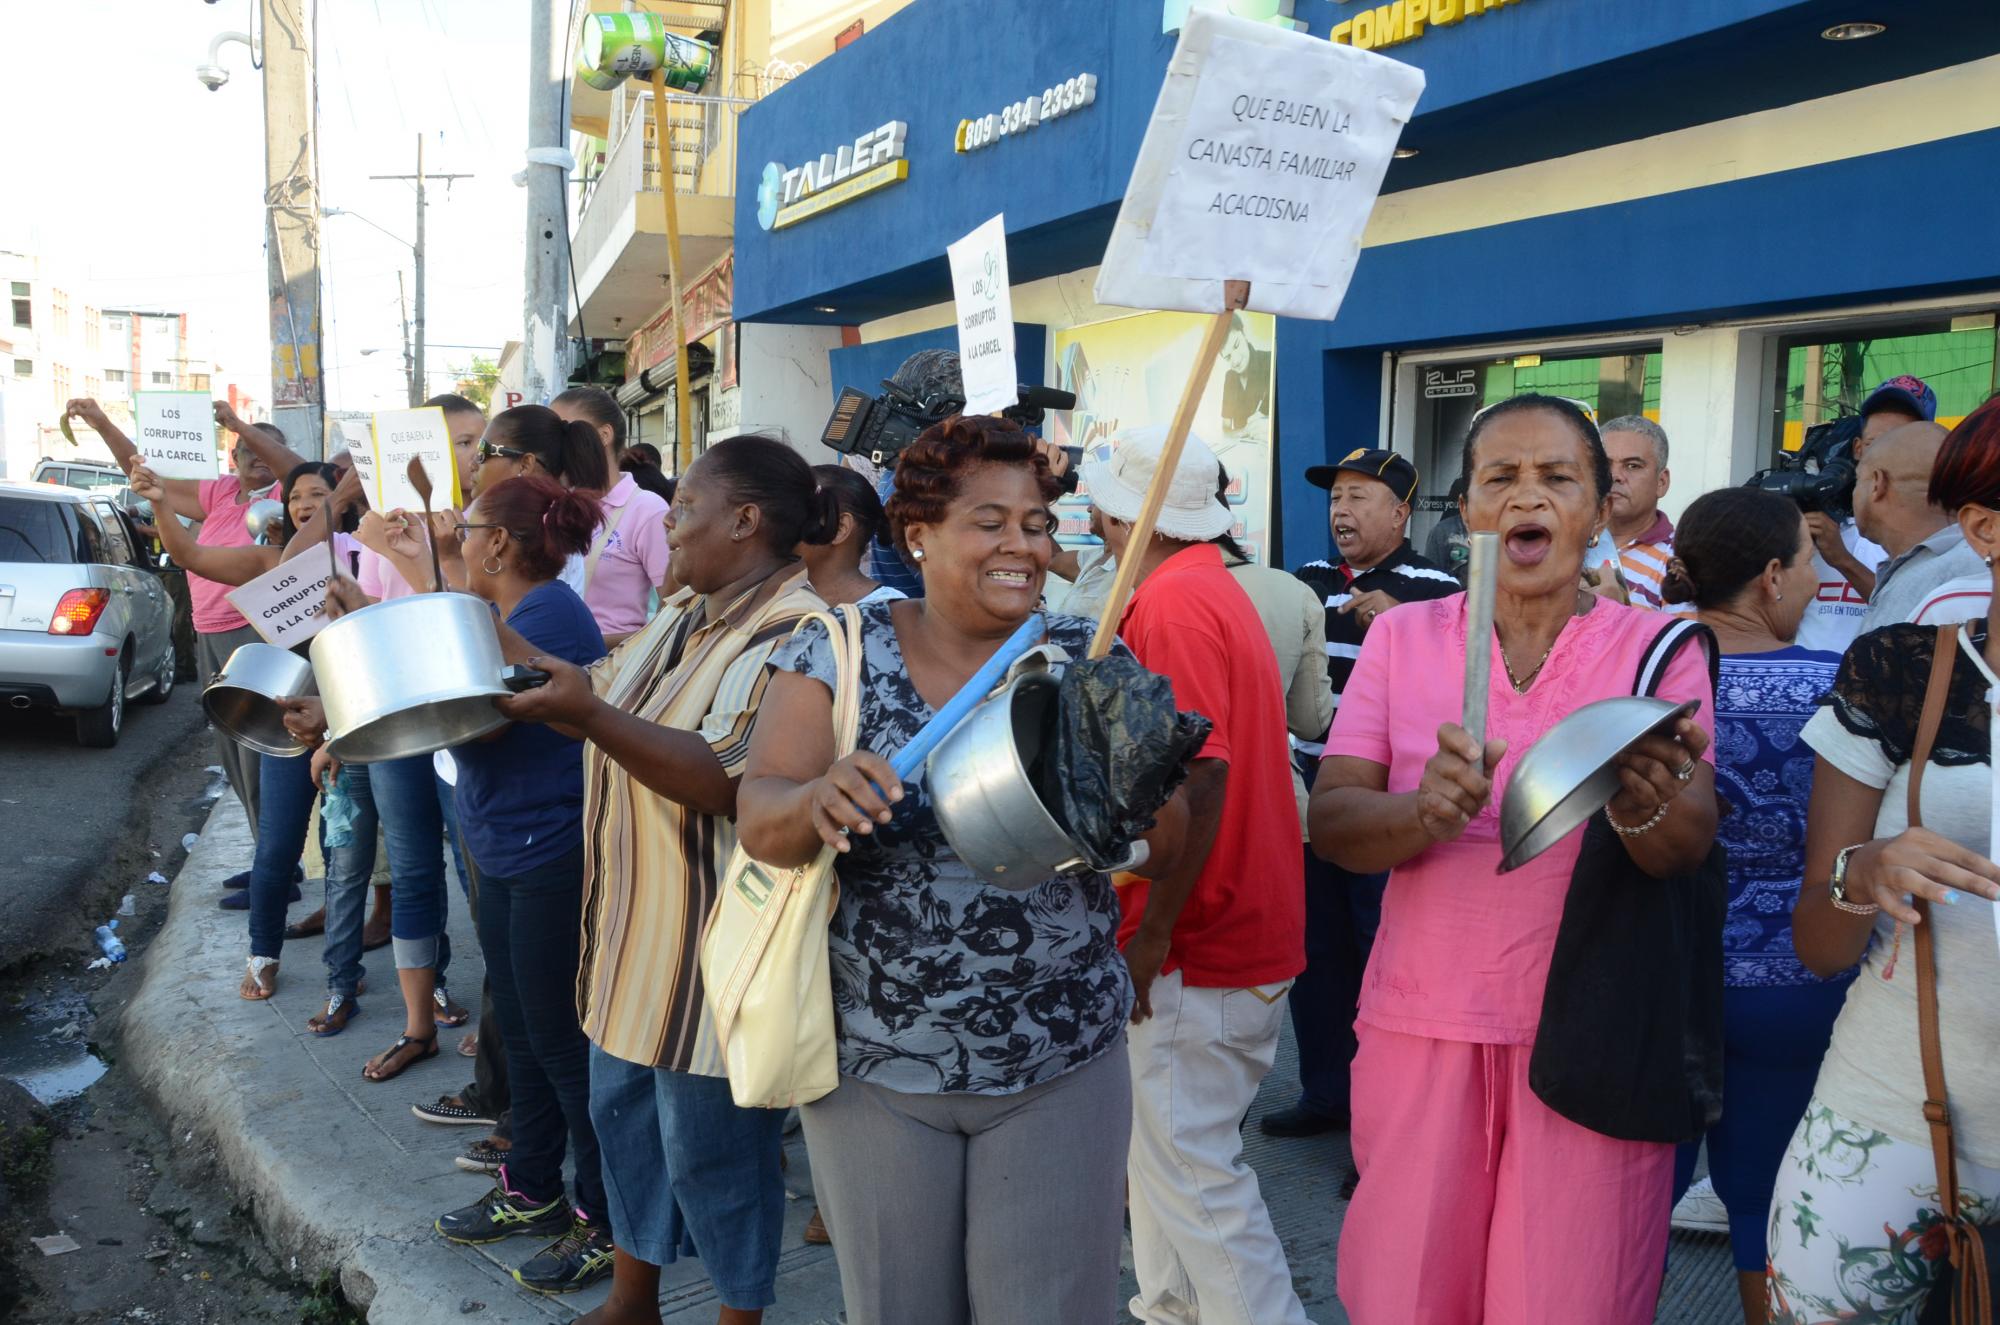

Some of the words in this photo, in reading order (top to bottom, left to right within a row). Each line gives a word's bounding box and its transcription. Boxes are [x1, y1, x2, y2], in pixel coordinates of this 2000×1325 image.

[965, 113, 998, 151] 809
[1000, 96, 1041, 135] 334
[1040, 73, 1098, 121] 2333
[1232, 94, 1272, 122] QUE
[1272, 100, 1329, 130] BAJEN
[1332, 110, 1351, 134] LA
[782, 120, 907, 204] TALLER
[1188, 138, 1272, 171] CANASTA
[1276, 151, 1357, 182] FAMILIAR
[1208, 192, 1311, 223] ACACDISNA
[972, 279, 983, 296] LOS
[964, 307, 997, 330] CORRUPTOS
[978, 338, 1002, 358] CARCEL
[161, 408, 181, 420] LOS
[144, 427, 203, 442] CORRUPTOS
[143, 447, 149, 457] A
[151, 448, 164, 459] LA
[166, 449, 207, 463] CARCEL
[272, 575, 298, 593] LOS
[276, 625, 287, 634] A
[286, 615, 304, 628] LA
[304, 599, 327, 617] CAR
[1834, 605, 1844, 616] EN
